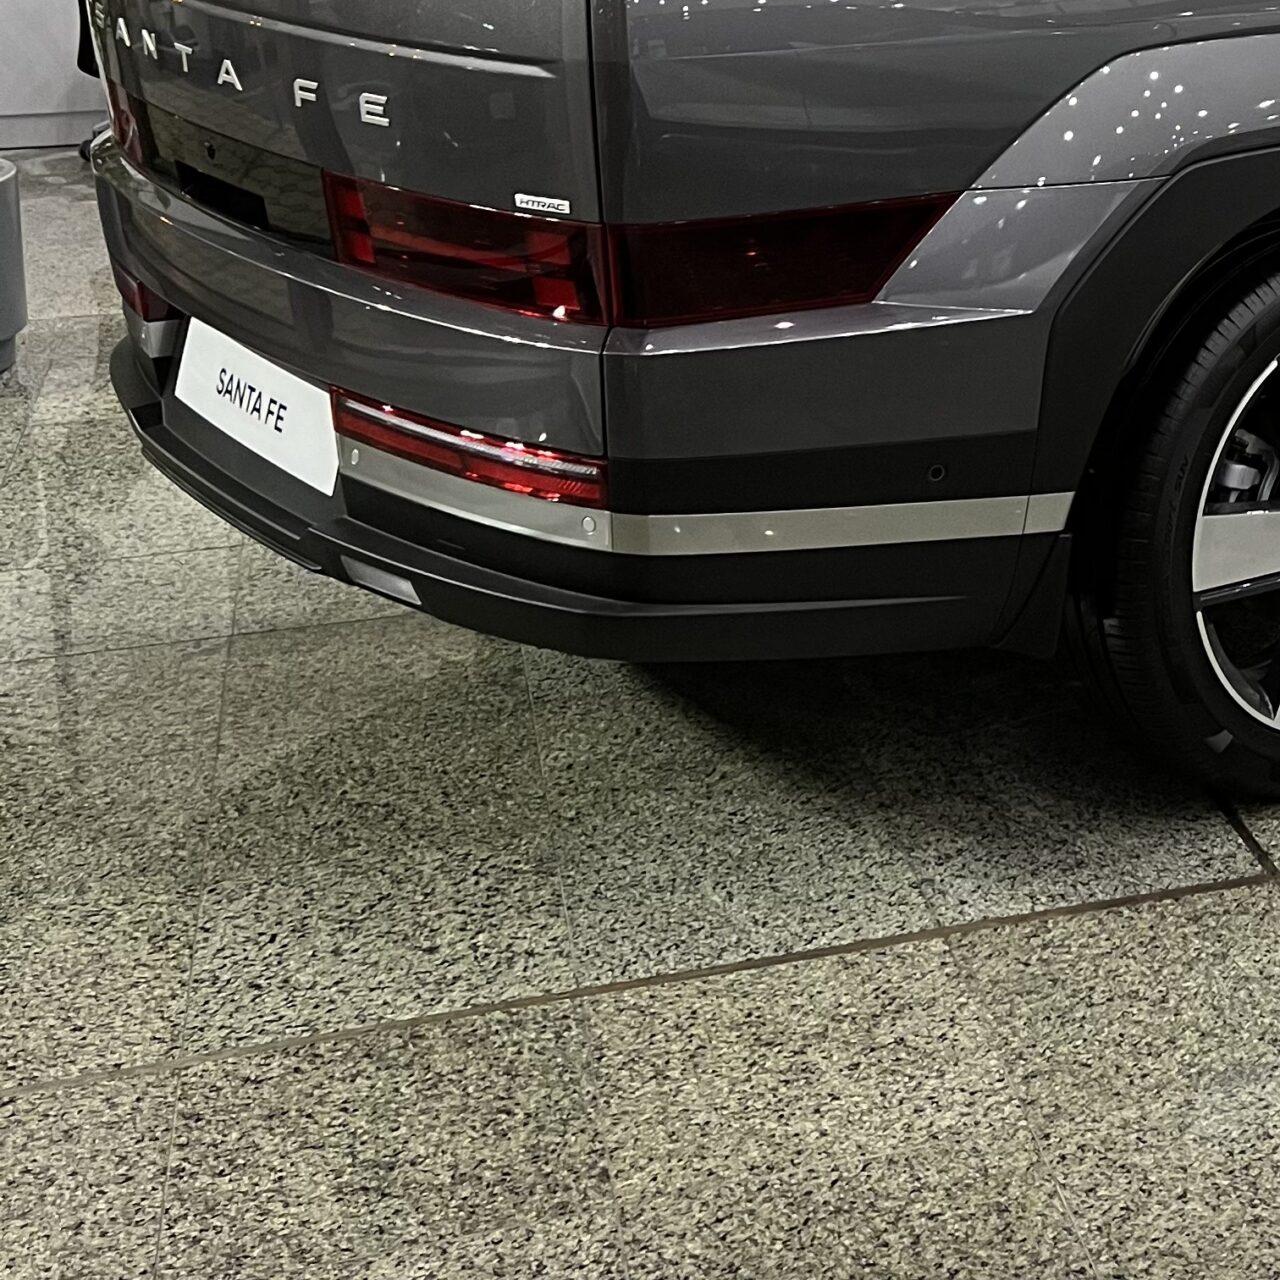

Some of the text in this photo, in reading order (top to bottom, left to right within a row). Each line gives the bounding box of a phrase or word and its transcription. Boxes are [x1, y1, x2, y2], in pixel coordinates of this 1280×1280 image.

[95, 2, 389, 126] SANTA FE
[519, 199, 566, 212] HTRAC
[216, 367, 287, 433] SANTA FE
